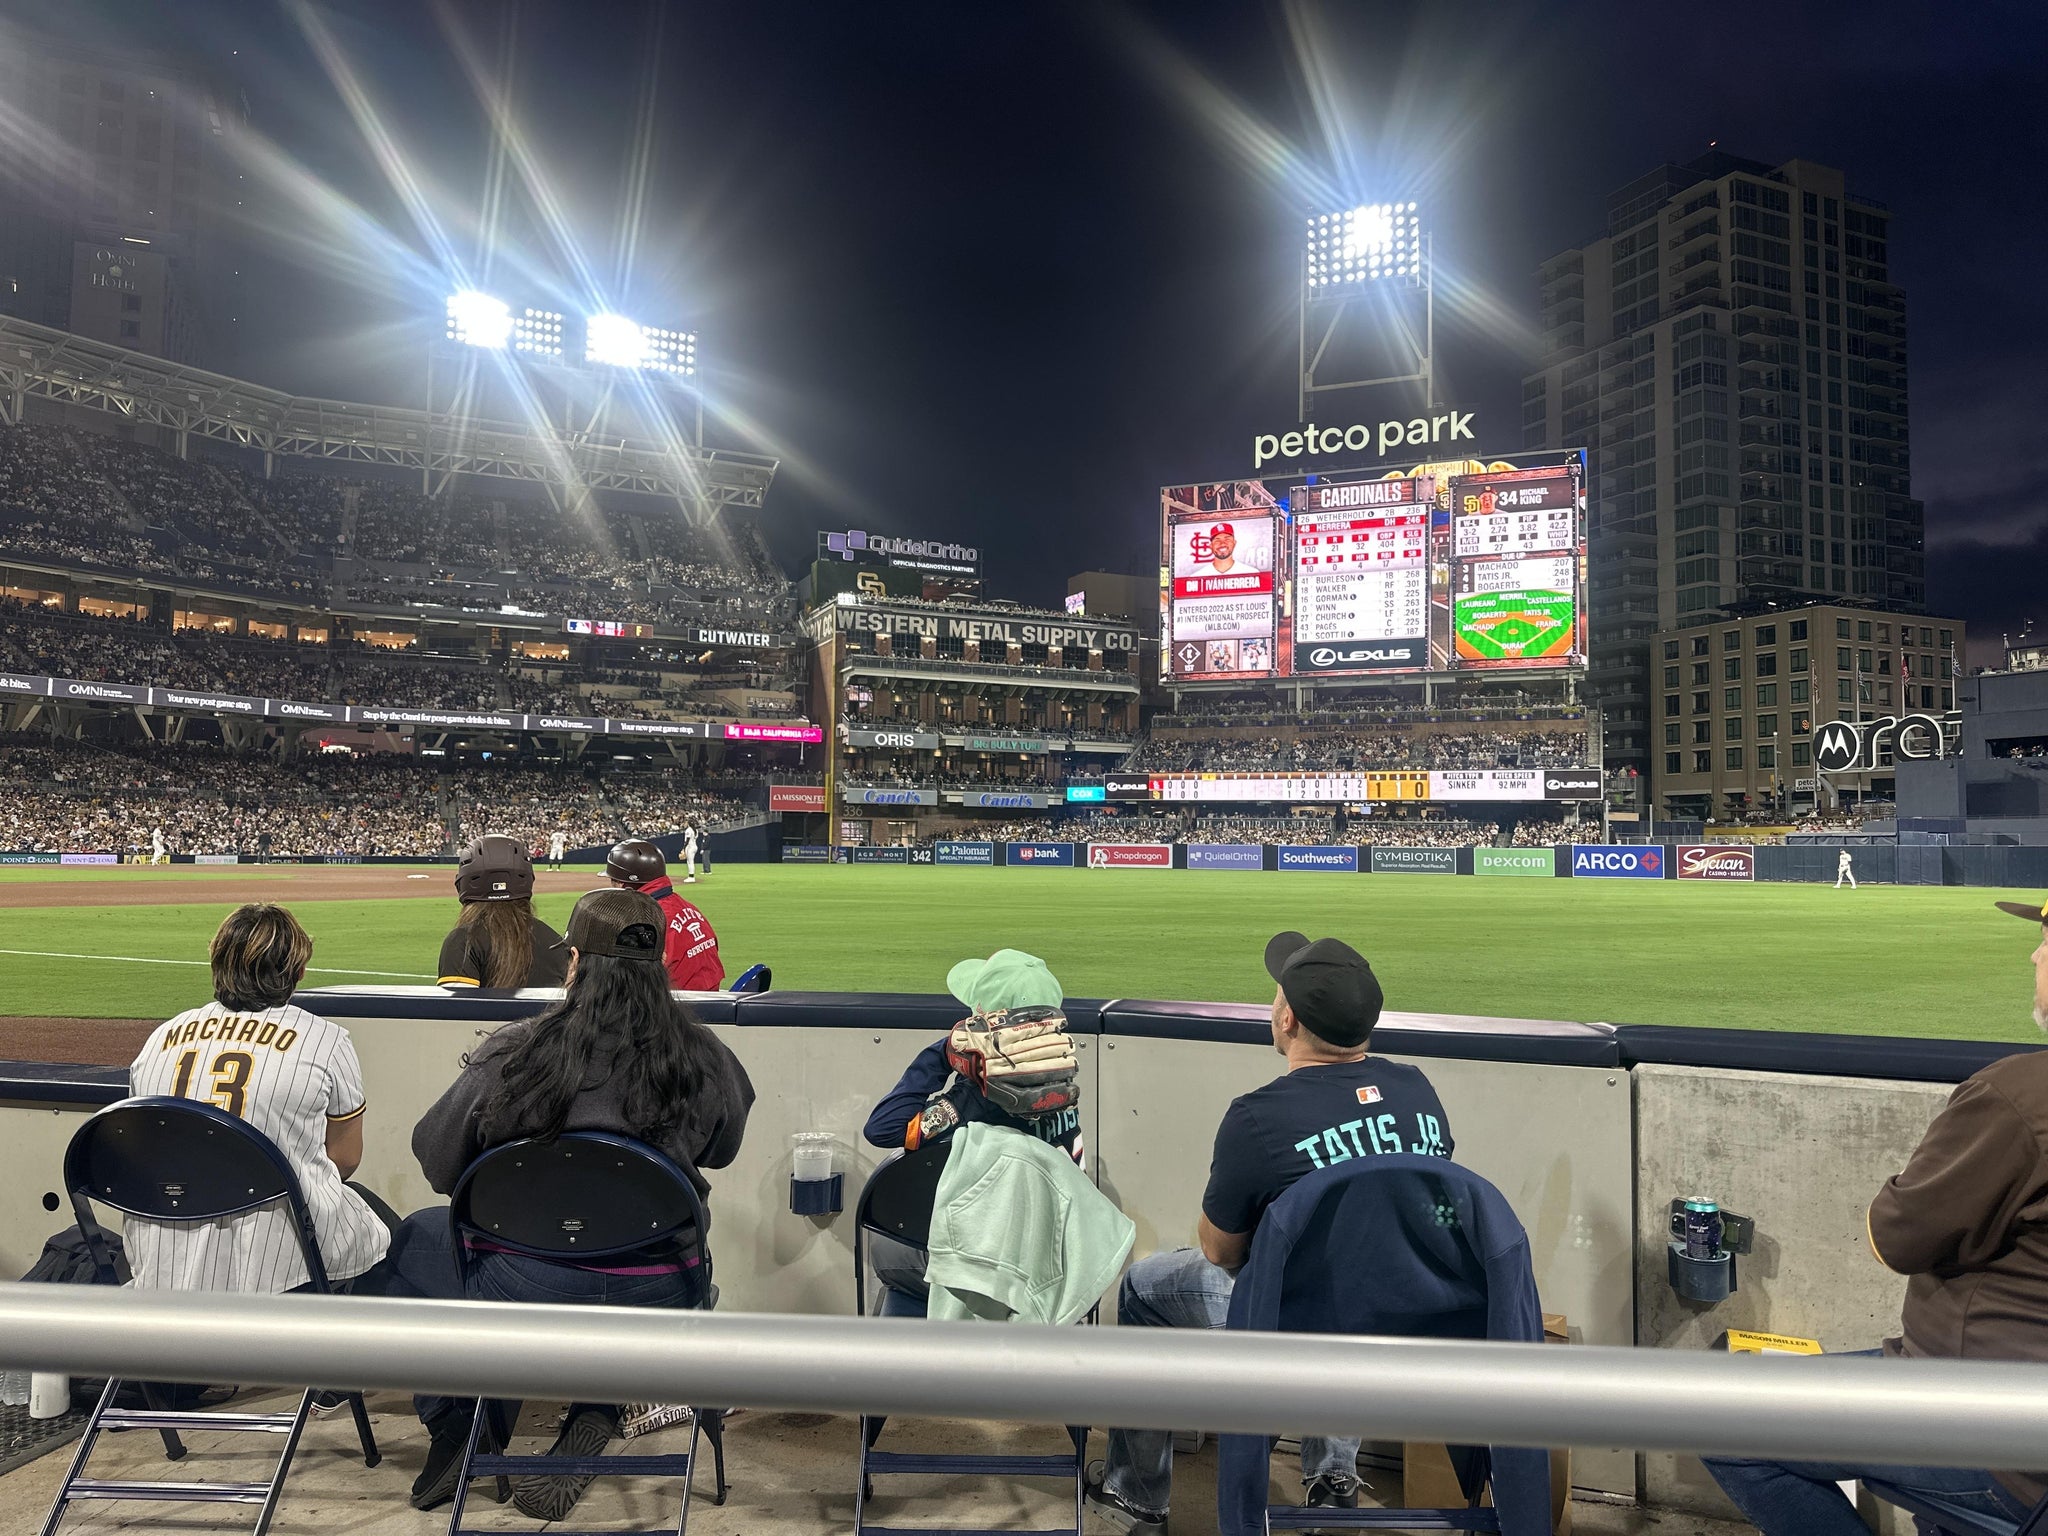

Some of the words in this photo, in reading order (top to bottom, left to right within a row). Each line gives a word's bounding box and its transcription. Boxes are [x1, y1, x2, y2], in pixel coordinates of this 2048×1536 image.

[96, 249, 136, 266] OMNI
[1255, 422, 1370, 469] petco
[1378, 410, 1475, 456] park
[1321, 482, 1402, 508] CARDINALS
[1499, 491, 1518, 506] 34
[1520, 488, 1549, 496] MICHAEL
[1520, 495, 1542, 504] KING
[1316, 511, 1365, 522] WETHERHOLT
[1316, 521, 1351, 532] HERRERA
[1384, 518, 1396, 526] DH
[1520, 524, 1536, 532] 3.82
[1549, 521, 1566, 529] 42.2
[870, 535, 977, 562] QuidelOrtho
[892, 560, 916, 568] OFFICIAL
[917, 561, 951, 571] DIAGNOSTICS
[952, 564, 974, 573] PARTNER
[1478, 562, 1518, 571] MACHADO
[1553, 558, 1569, 566] .207
[1316, 575, 1356, 584] BURLESON
[1478, 572, 1498, 580] TATIS
[1502, 572, 1512, 580] JR.
[1553, 568, 1569, 576] .248
[1206, 578, 1223, 591] IVÁN
[1224, 576, 1260, 590] HERRERA
[1316, 584, 1346, 593] WALKER
[1478, 581, 1520, 590] BOGAERTS
[1316, 594, 1348, 602] GORMAN
[1462, 600, 1496, 608] LAUREANO
[1528, 596, 1571, 604] CASTELLANOS
[1180, 606, 1208, 614] ENTERED
[1209, 604, 1224, 612] 2022
[1236, 604, 1244, 612] ST.
[1472, 611, 1506, 619] BOGAERTS
[1185, 613, 1234, 622] INTERNATIONAL
[1236, 611, 1269, 620] PROSPECT
[1316, 612, 1346, 621] CHURCH
[1385, 610, 1394, 618] LF
[837, 610, 938, 636] WESTERN
[950, 619, 1016, 642] METAL
[1022, 626, 1104, 648] SUPPLY
[1106, 632, 1136, 651] CO.
[1205, 622, 1240, 632] (MLB.COM)
[1462, 623, 1495, 631] MACHADO
[699, 630, 770, 647] CUTWATER
[1316, 631, 1339, 640] SCOTT
[1338, 648, 1412, 662] LEXUS
[9, 680, 32, 690] bites.
[69, 684, 102, 696] OMNI
[168, 694, 184, 704] Your
[185, 697, 200, 705] new
[200, 698, 215, 708] post
[216, 699, 235, 709] game
[236, 700, 252, 710] stop.
[280, 704, 309, 714] OMNI
[364, 711, 380, 721] Stop
[380, 712, 390, 721] by
[390, 712, 402, 720] the
[402, 712, 420, 722] Omni
[422, 713, 430, 722] for
[431, 714, 447, 724] post
[447, 716, 466, 725] game
[466, 716, 486, 725] drinks
[486, 716, 493, 725] &
[494, 716, 511, 726] bites.
[540, 720, 567, 728] OMNI
[621, 722, 636, 732] Your
[649, 724, 662, 734] post
[663, 726, 679, 734] game
[680, 726, 694, 735] stop.
[762, 730, 802, 738] CALIFORNIA
[874, 734, 914, 747] ORIS
[974, 740, 988, 748] BIG
[991, 740, 1017, 750] BULLY
[1415, 782, 1424, 798] 0
[1448, 781, 1476, 790] SINKER
[864, 790, 921, 804] Canel's
[980, 794, 1033, 808] Canel's
[843, 806, 862, 817] 336
[912, 850, 931, 862] 342
[952, 845, 990, 856] Palomar
[1022, 850, 1032, 858] us
[1034, 848, 1059, 858] bank
[1114, 850, 1162, 862] Snapdragon
[1204, 852, 1259, 864] QuidelOrtho
[1283, 852, 1344, 864] Southwest
[1374, 852, 1452, 862] CYMBIOTIKA
[1576, 853, 1638, 871] ARCO
[1683, 849, 1746, 876] Sycuan
[670, 908, 704, 934] ELITE
[161, 1016, 298, 1054] MACHADO
[172, 1048, 256, 1120] 13
[938, 1099, 958, 1124] PADRES
[1294, 1113, 1402, 1170] TATIS
[1738, 1333, 1772, 1342] MASON
[1773, 1338, 1808, 1347] MILLER
[638, 1416, 663, 1435] TEAM
